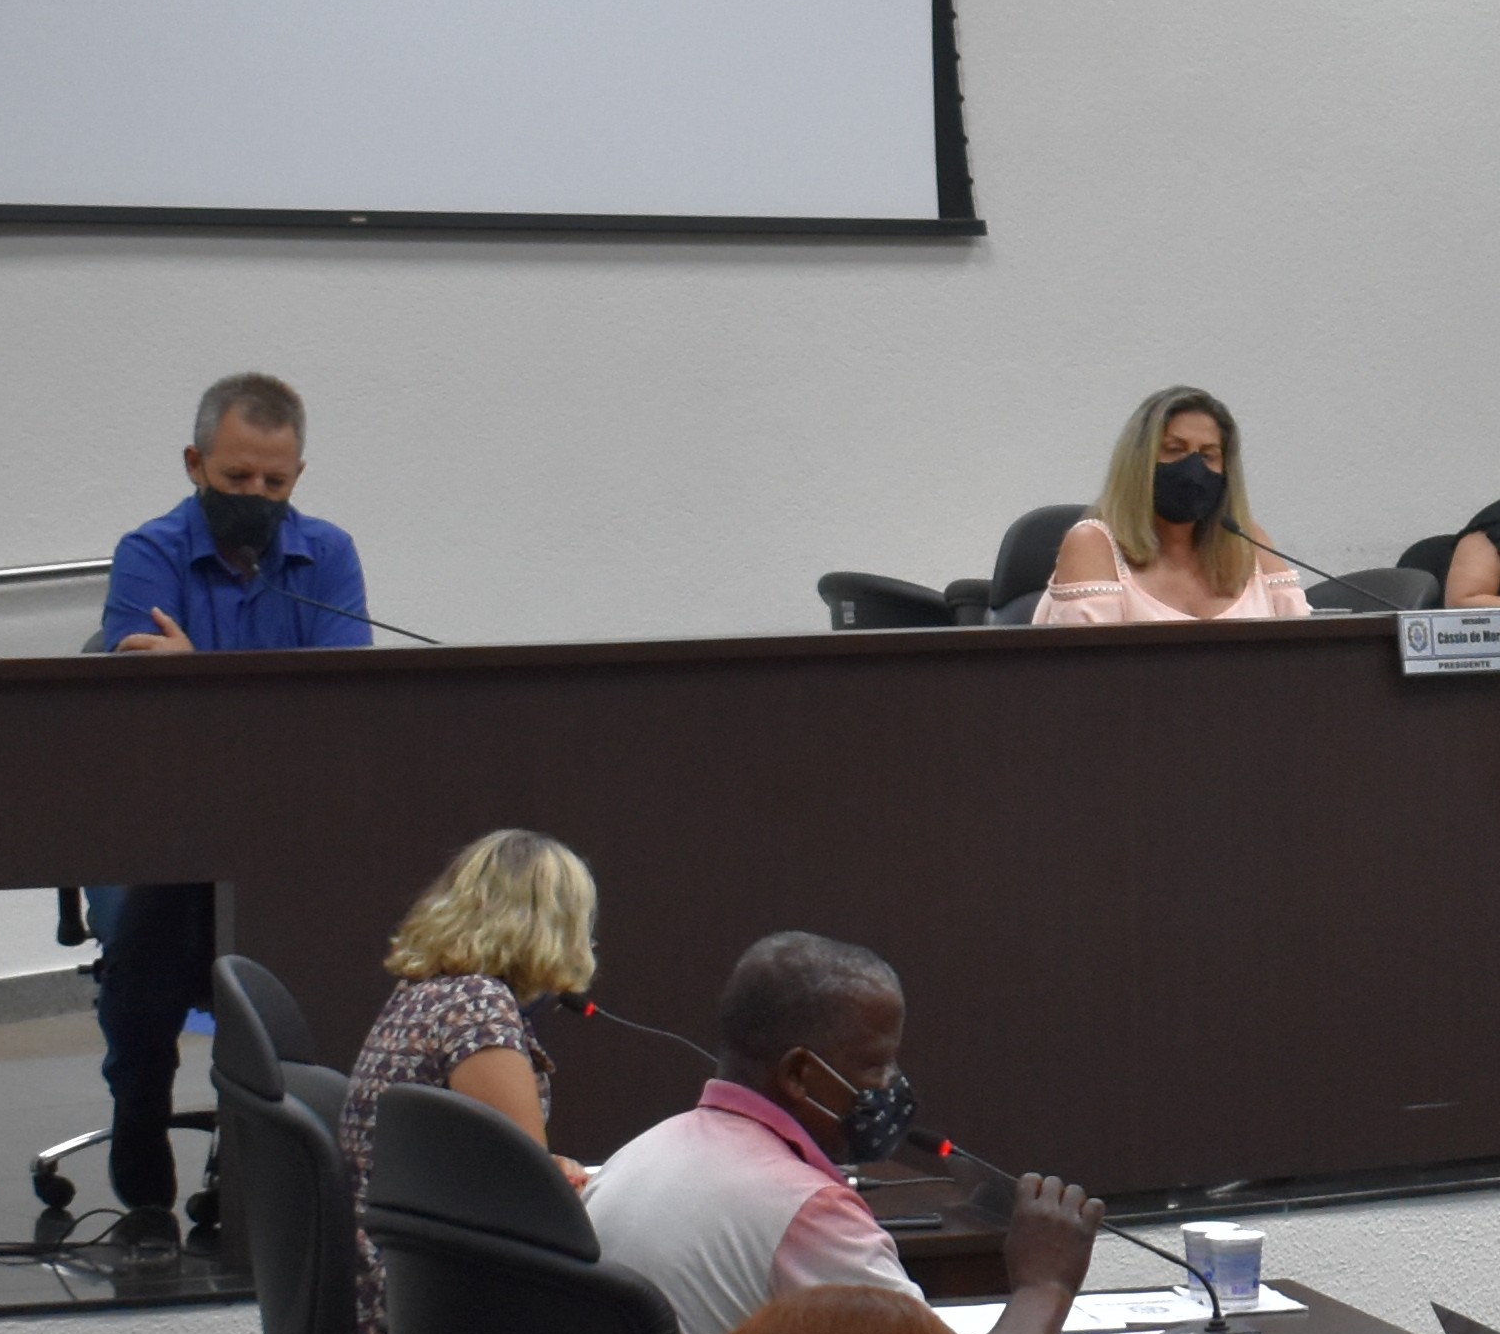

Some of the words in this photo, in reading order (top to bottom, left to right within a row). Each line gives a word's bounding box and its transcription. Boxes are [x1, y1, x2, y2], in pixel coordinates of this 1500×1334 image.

[1437, 630, 1469, 644] Cássia
[1470, 630, 1481, 643] de
[1438, 660, 1491, 670] PRESIDENTE
